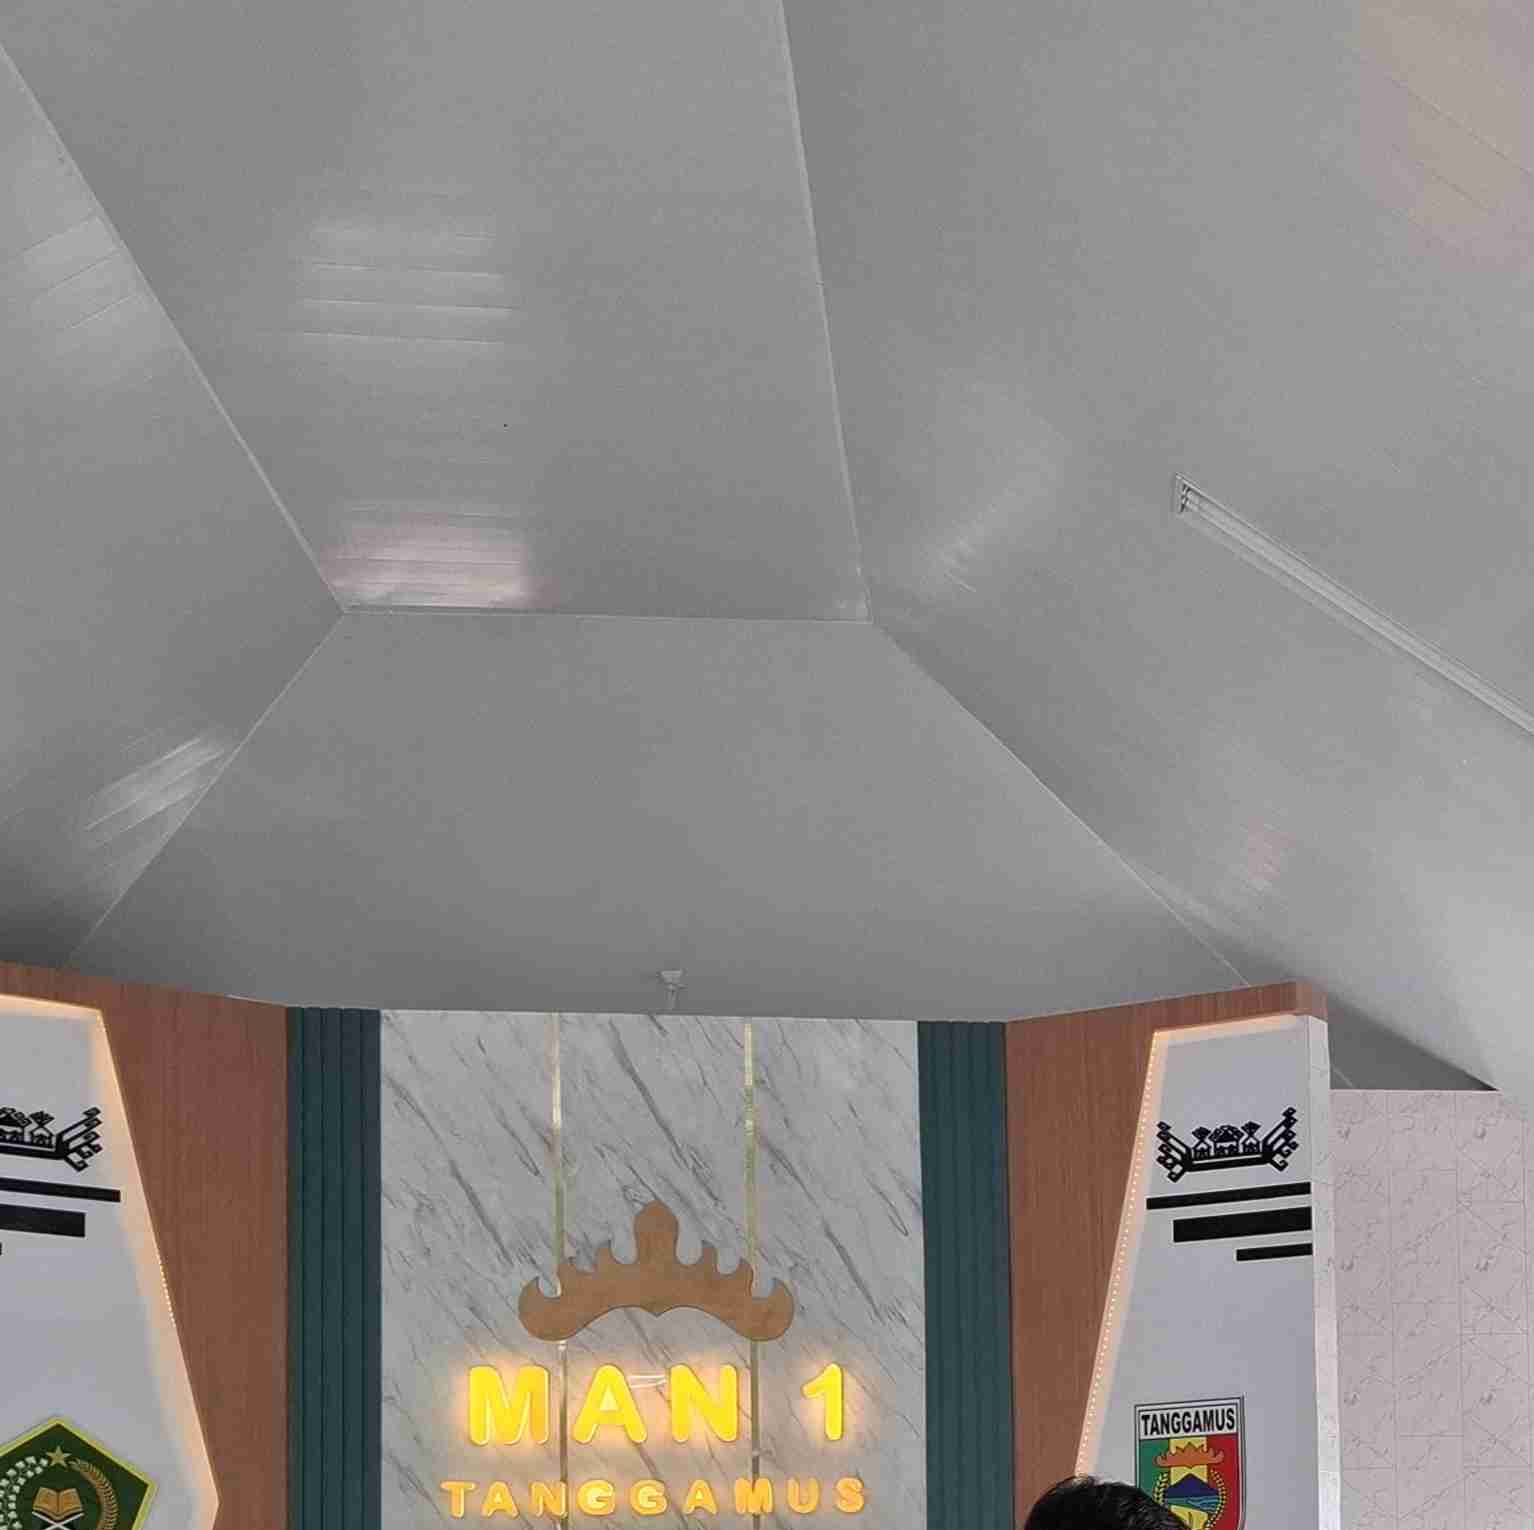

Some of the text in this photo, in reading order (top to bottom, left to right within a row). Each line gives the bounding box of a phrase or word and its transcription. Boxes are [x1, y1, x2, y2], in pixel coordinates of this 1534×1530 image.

[468, 1363, 846, 1446] MAN 1
[1141, 1408, 1235, 1436] TANGGAMUS
[441, 1477, 866, 1518] TANGGAMUS
